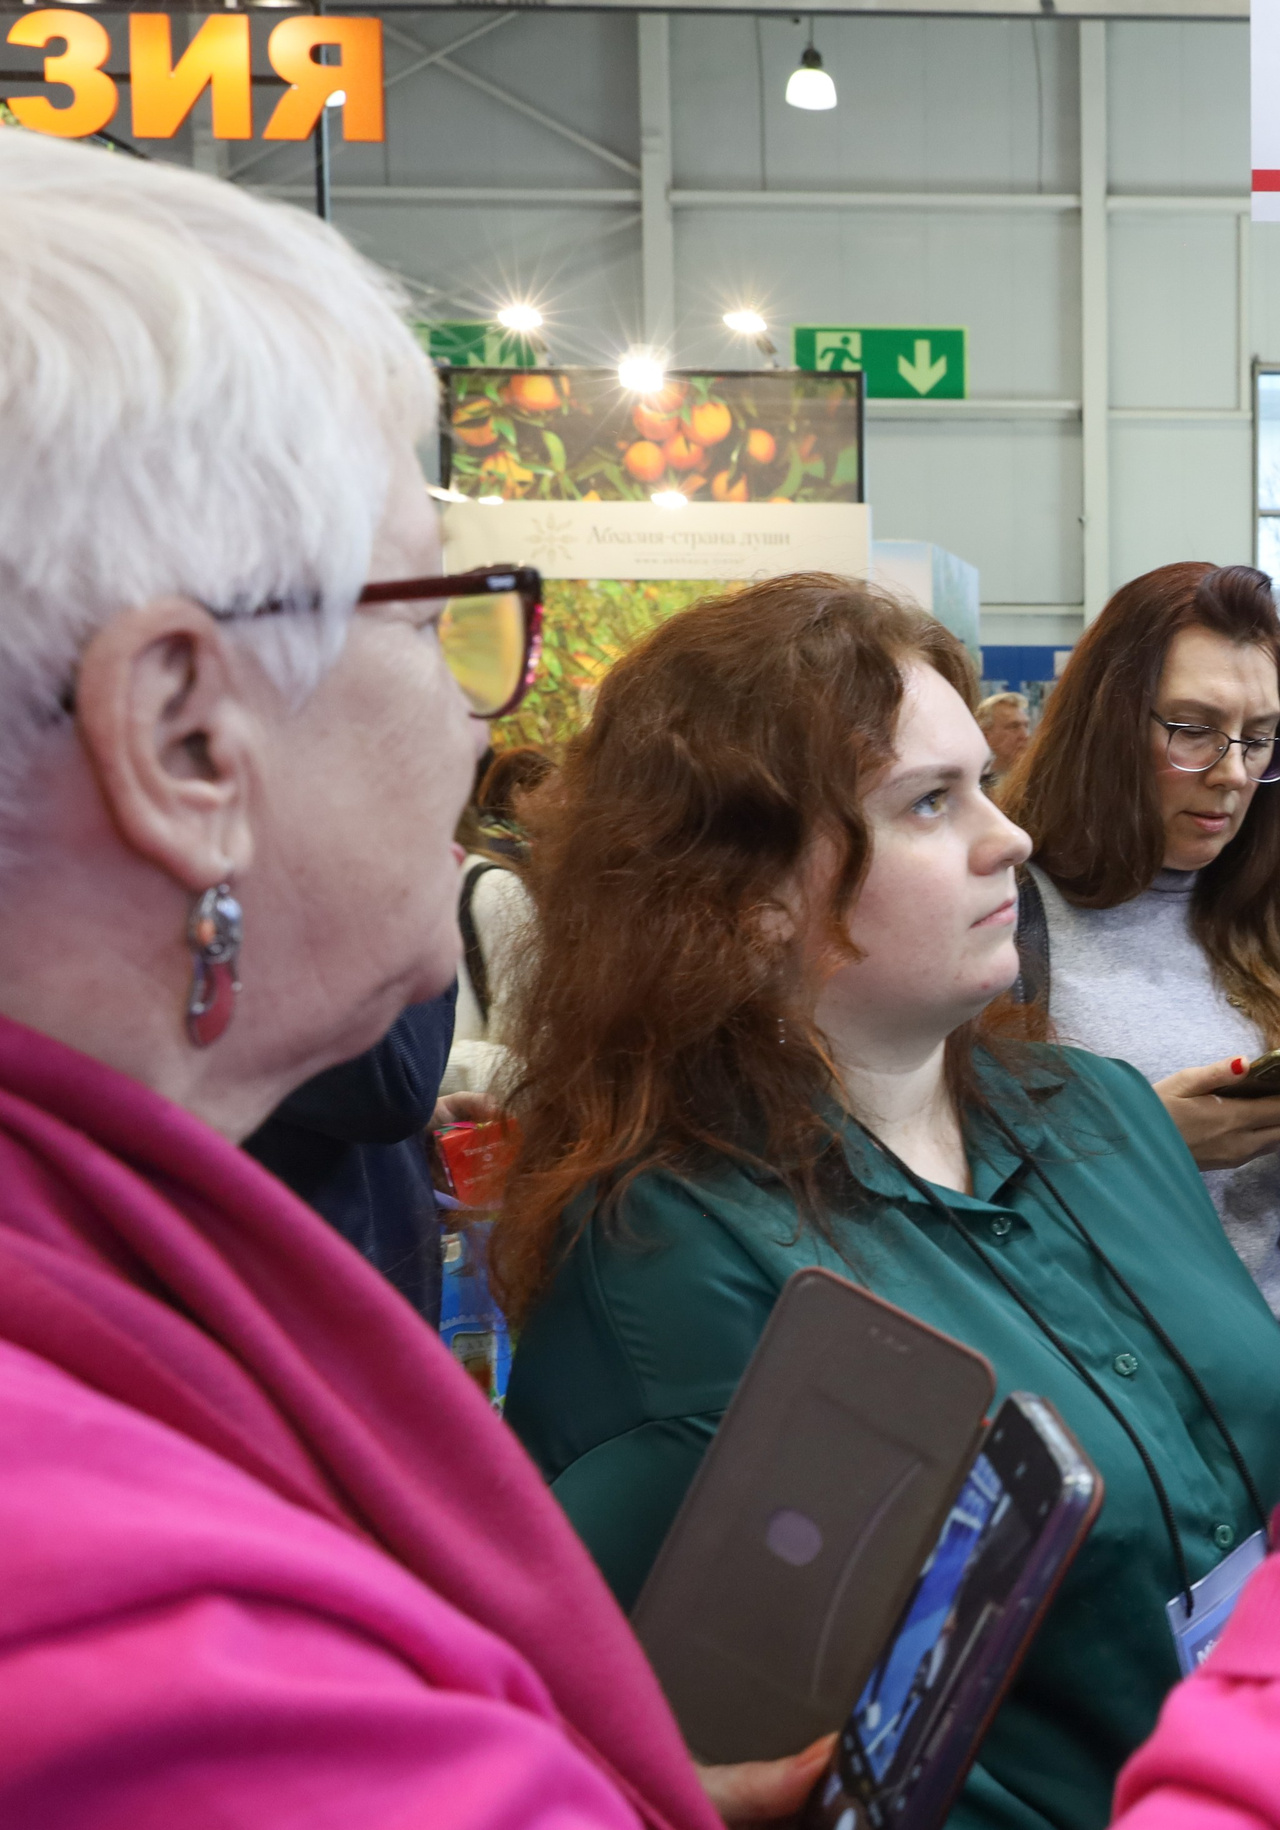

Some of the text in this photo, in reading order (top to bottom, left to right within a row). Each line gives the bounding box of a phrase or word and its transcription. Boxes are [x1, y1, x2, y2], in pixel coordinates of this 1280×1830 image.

[7, 9, 385, 142] ЗИЯ
[586, 525, 790, 551] Абхазия-страна души
